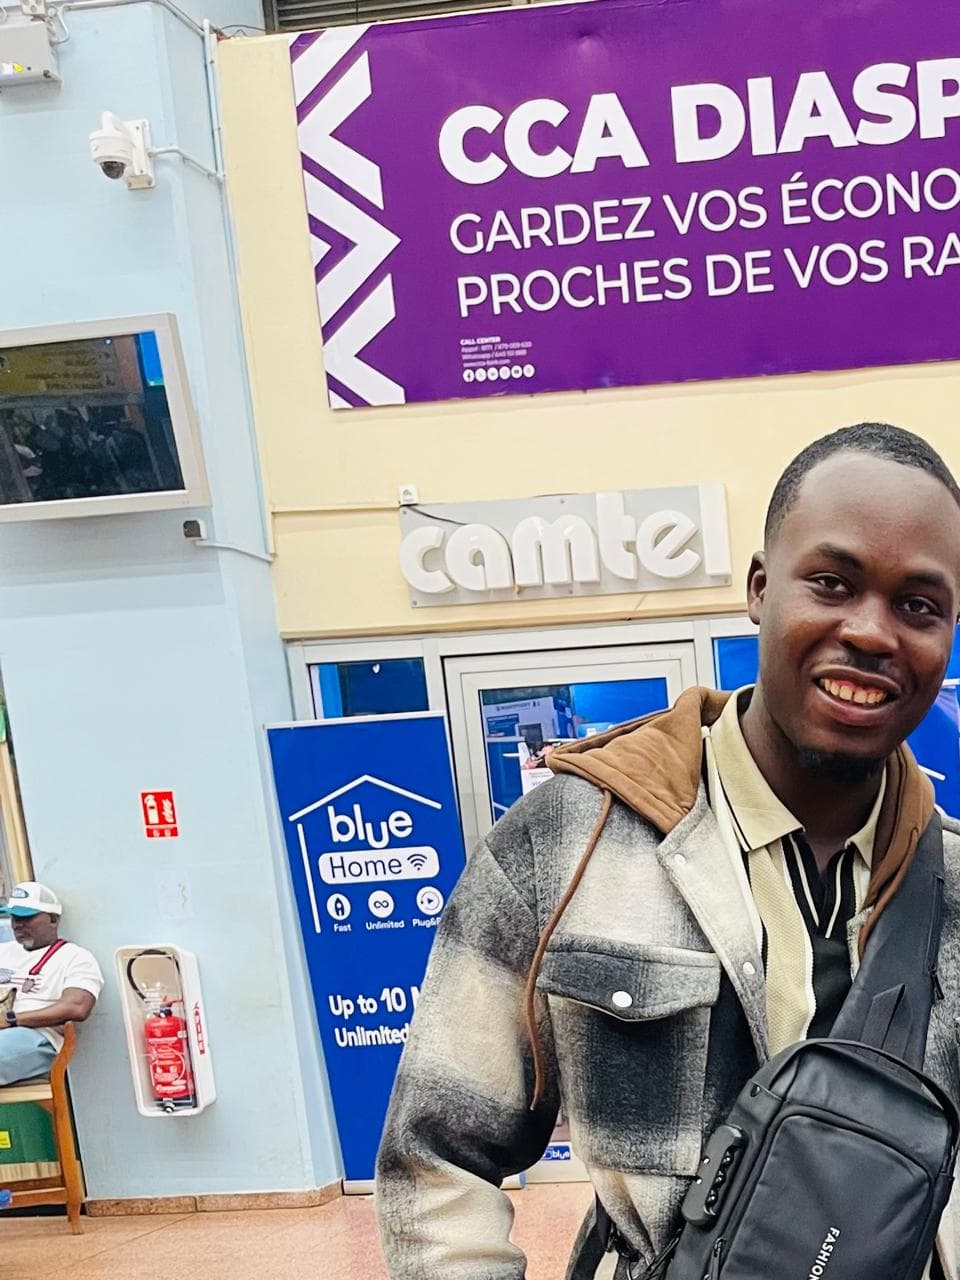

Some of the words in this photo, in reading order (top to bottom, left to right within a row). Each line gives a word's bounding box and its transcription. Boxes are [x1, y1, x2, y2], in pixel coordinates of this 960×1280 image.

[438, 82, 650, 185] CCA
[449, 196, 655, 254] GARDEZ
[662, 186, 768, 235] VOS
[457, 257, 693, 318] PROCHES
[705, 249, 775, 297] DE
[783, 238, 889, 289] VOS
[400, 483, 732, 593] camtel
[327, 803, 413, 849] blue
[329, 855, 402, 879] Home
[333, 921, 352, 932] Fast
[365, 919, 405, 931] Unlimited
[328, 994, 355, 1020] Up
[356, 994, 378, 1014] to
[380, 986, 407, 1013] 10
[334, 1023, 410, 1048] Unlimited
